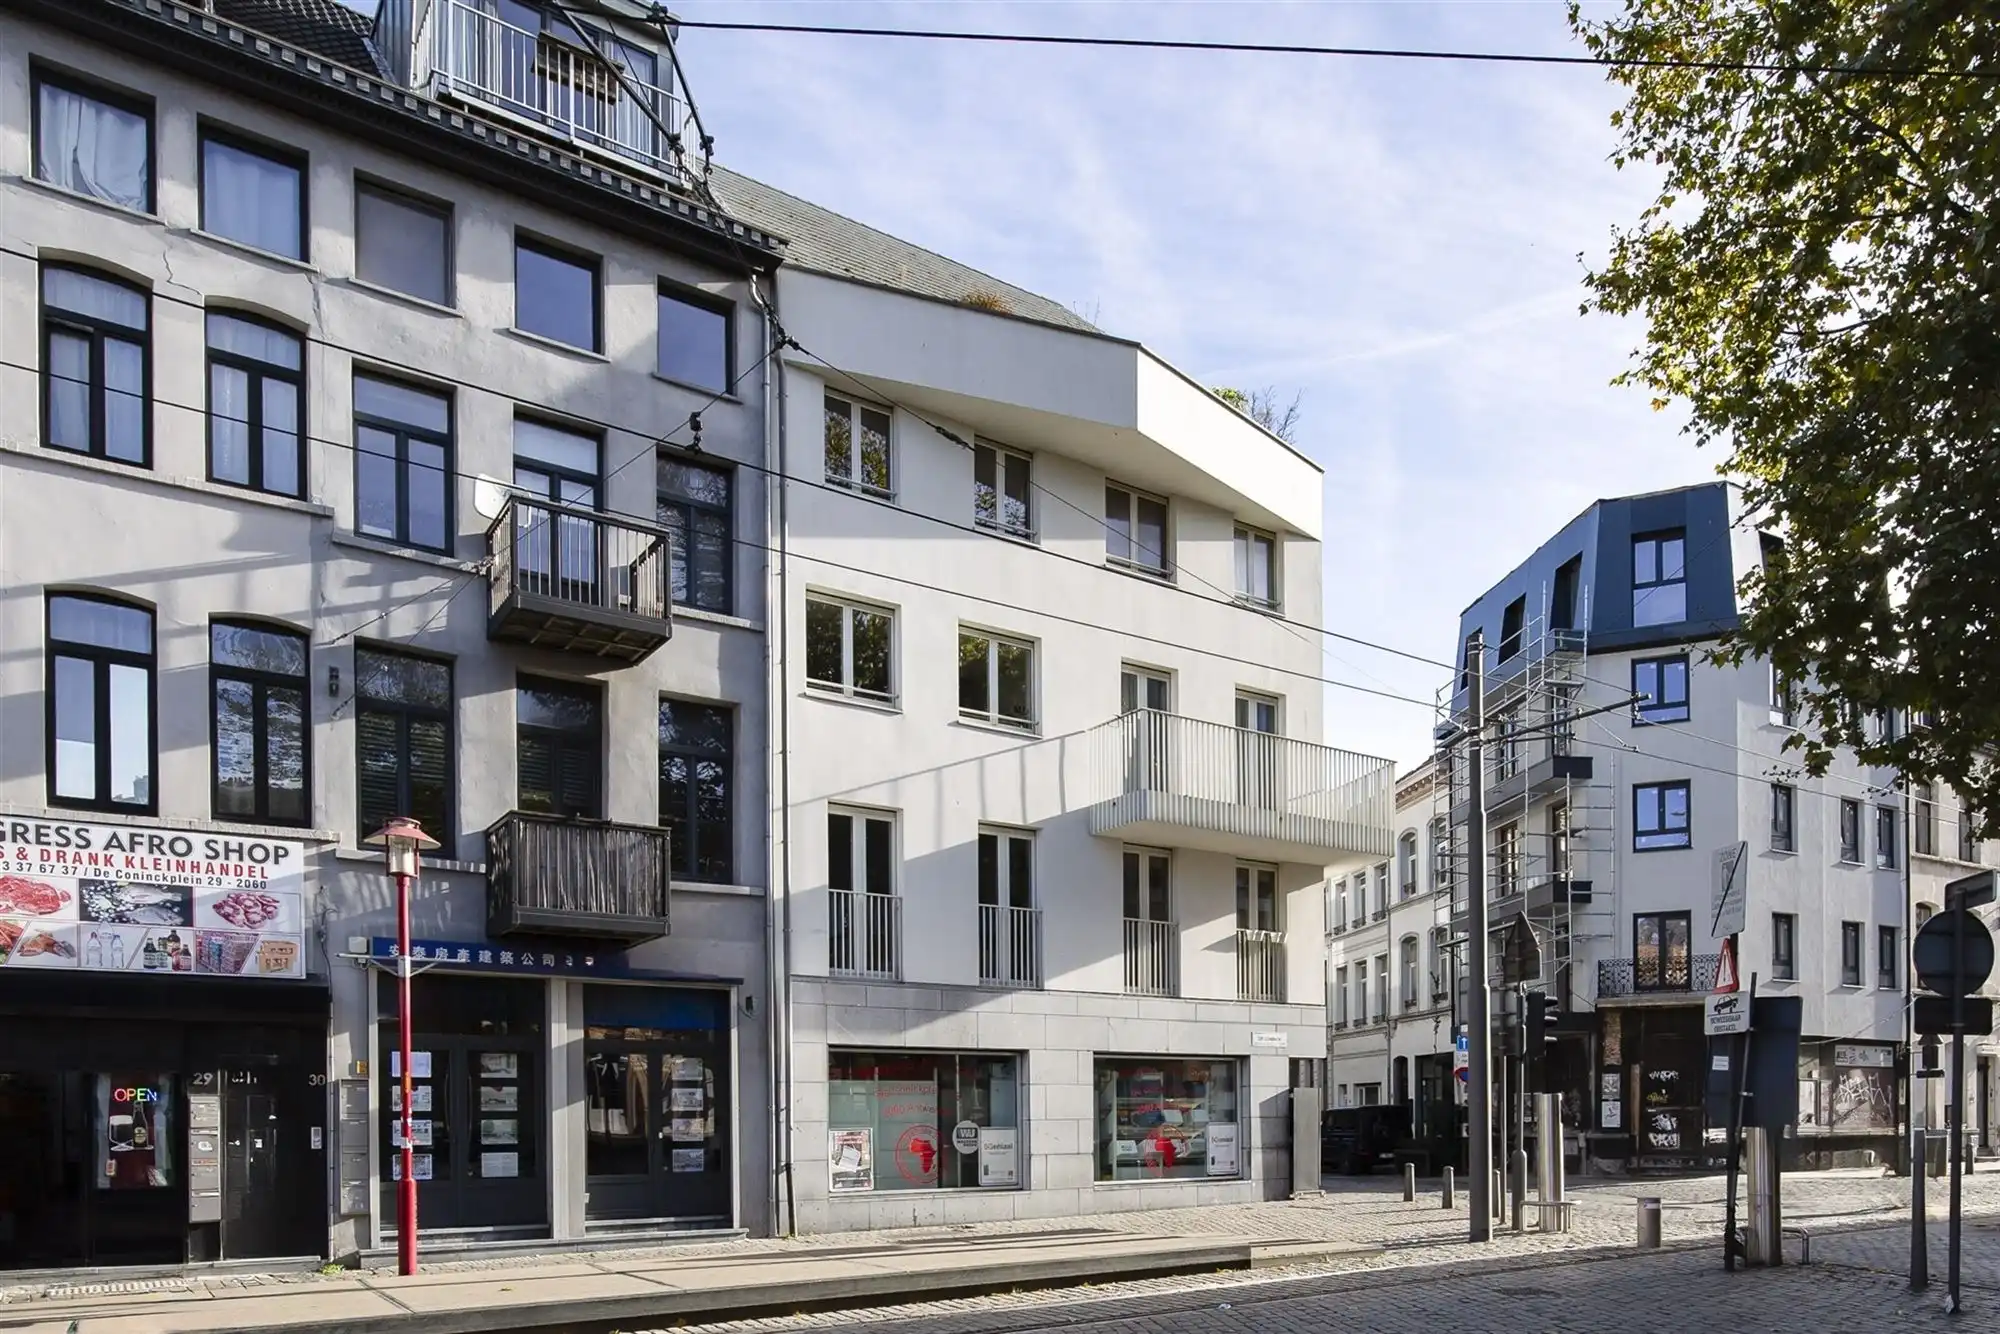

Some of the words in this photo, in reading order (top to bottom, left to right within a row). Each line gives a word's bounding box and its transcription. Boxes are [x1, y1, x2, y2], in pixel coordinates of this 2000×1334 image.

[103, 832, 193, 858] AFRO
[205, 839, 289, 865] SHOP
[16, 847, 28, 861] &
[40, 848, 114, 868] DRANK
[125, 855, 269, 879] KLEINHANDEL
[16, 862, 32, 872] 37
[39, 864, 55, 874] 67
[62, 865, 78, 876] 37
[94, 868, 110, 878] De
[116, 869, 202, 884] Coninckplein
[207, 876, 222, 886] 29
[236, 879, 267, 889] 2060
[192, 1072, 213, 1085] 29
[308, 1074, 326, 1086] 30
[114, 1088, 157, 1102] OPEN
